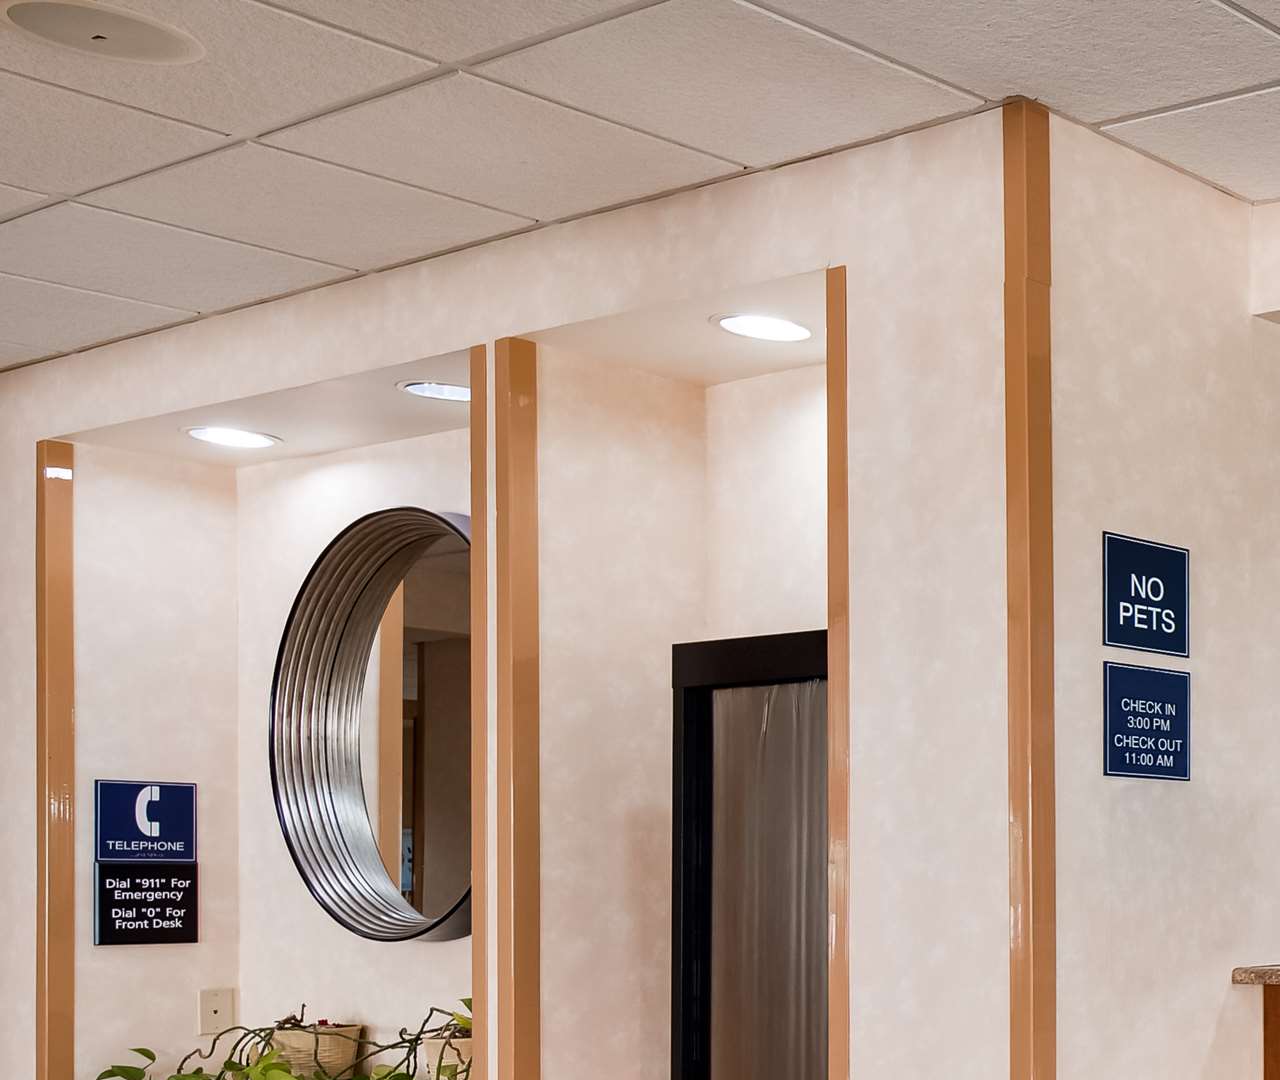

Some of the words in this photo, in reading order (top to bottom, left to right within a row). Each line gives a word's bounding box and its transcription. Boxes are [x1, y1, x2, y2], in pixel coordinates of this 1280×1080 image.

[1131, 573, 1164, 601] NO
[1119, 602, 1176, 634] PETS
[1121, 698, 1162, 715] CHECK
[1165, 703, 1176, 716] IN
[1127, 716, 1150, 730] 3:00
[1153, 718, 1170, 731] PM
[1114, 734, 1155, 750] CHECK
[1158, 738, 1182, 752] OUT
[1124, 753, 1153, 766] 11:00
[1156, 755, 1174, 767] AM
[106, 840, 184, 851] TELEPHONE
[106, 879, 130, 889] Dial
[135, 879, 166, 888] "911"
[171, 879, 191, 888] For
[114, 889, 183, 901] Emergency
[112, 908, 136, 918] Dial
[141, 908, 160, 918] "0"
[166, 908, 186, 917] For
[115, 919, 149, 929] Front
[153, 919, 183, 928] Desk
